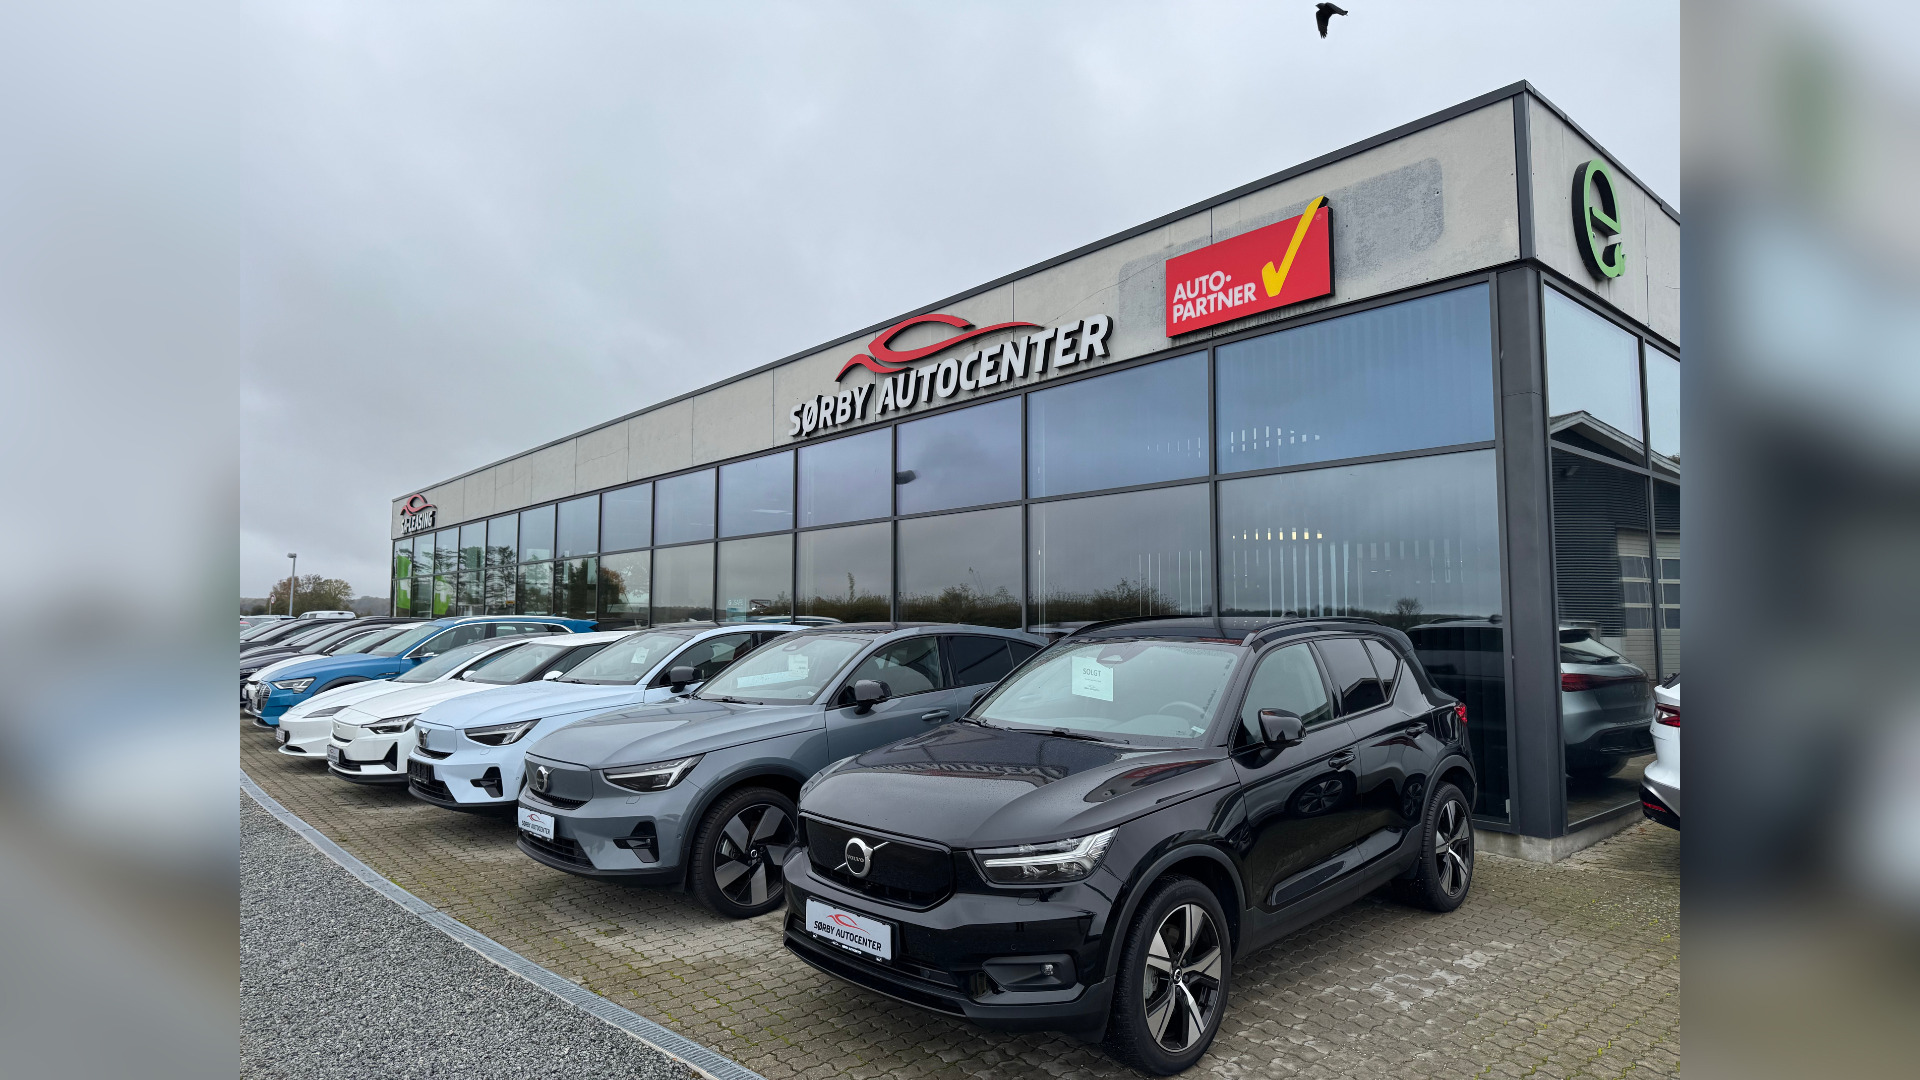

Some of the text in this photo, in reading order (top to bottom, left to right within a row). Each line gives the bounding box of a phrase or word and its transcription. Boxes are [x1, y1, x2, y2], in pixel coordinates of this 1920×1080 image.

[1173, 282, 1257, 324] PARTNER
[788, 313, 1112, 437] SØRBY AUTOCENTER
[1082, 667, 1102, 677] SOLGT
[846, 854, 865, 863] VOLVO
[814, 920, 835, 934] SØRBY
[835, 928, 881, 951] AUTOCENTER
